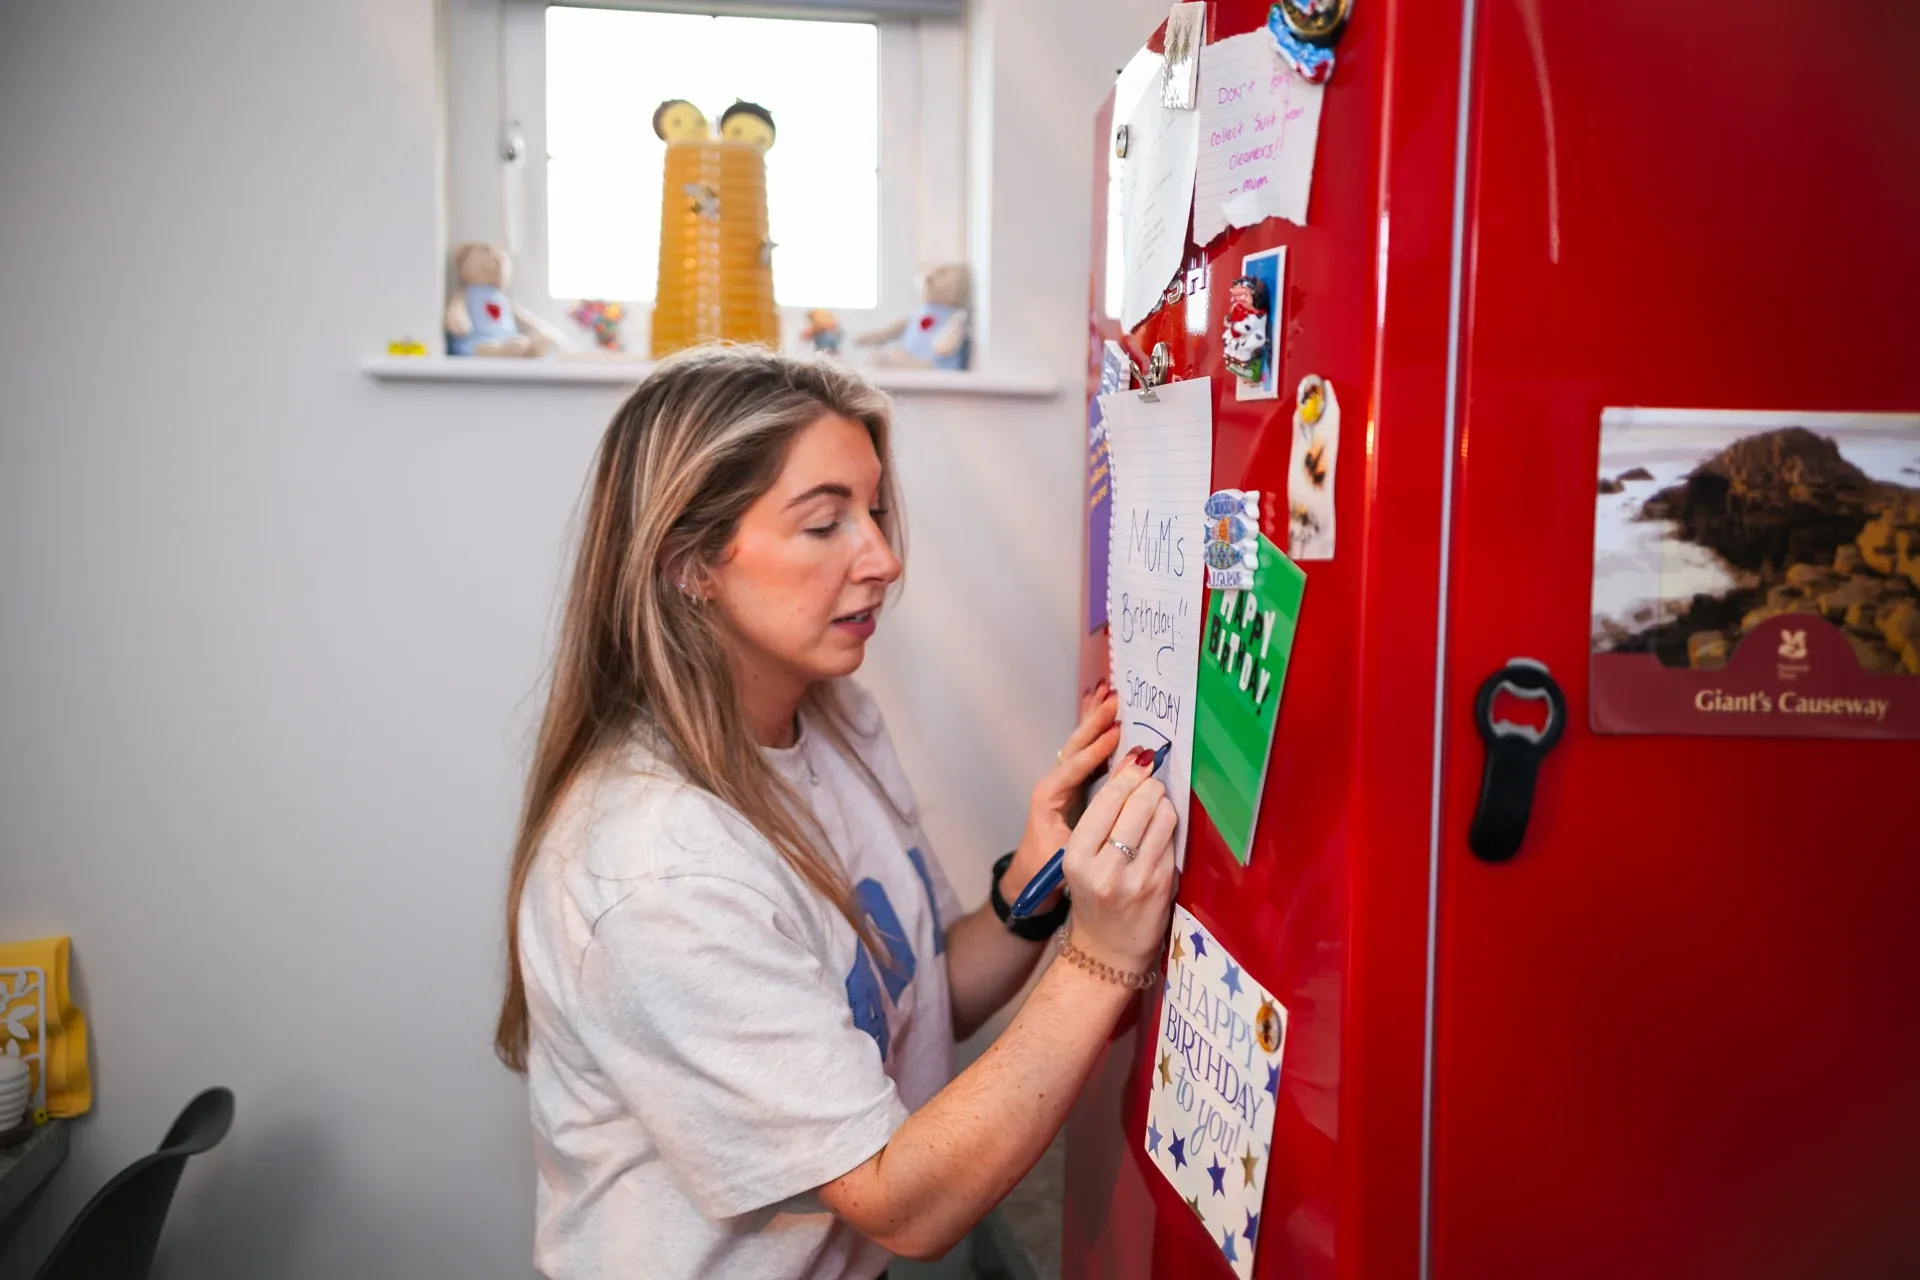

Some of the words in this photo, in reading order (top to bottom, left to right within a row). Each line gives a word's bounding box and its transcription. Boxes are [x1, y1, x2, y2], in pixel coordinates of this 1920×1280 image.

[1219, 589, 1277, 660] HAPPY
[1126, 669, 1182, 736] SATURDAY
[1694, 688, 1773, 713] Giant's
[1778, 691, 1890, 722] Causeway
[1176, 961, 1258, 1072] HAPPY
[1164, 1000, 1264, 1132] BIRTHDAY
[1174, 1065, 1195, 1113] to
[1189, 1098, 1242, 1166] you!
